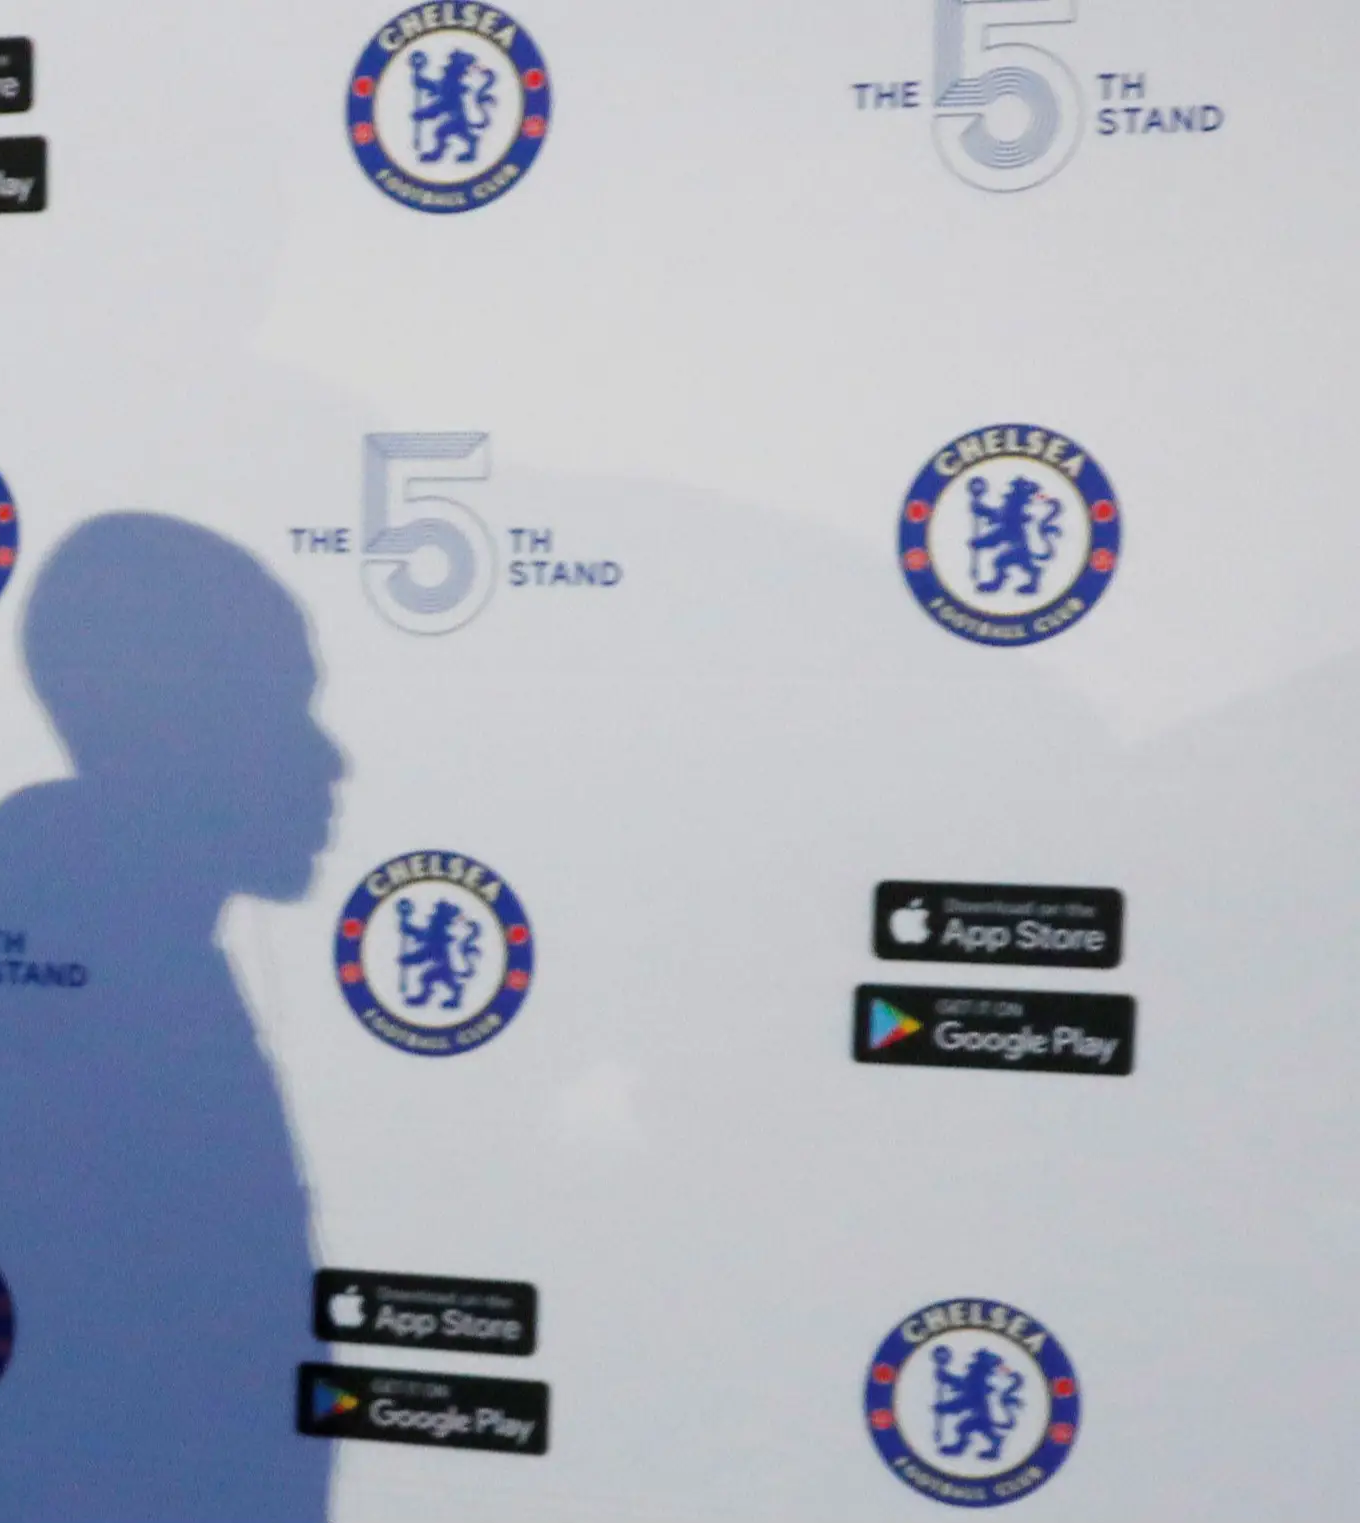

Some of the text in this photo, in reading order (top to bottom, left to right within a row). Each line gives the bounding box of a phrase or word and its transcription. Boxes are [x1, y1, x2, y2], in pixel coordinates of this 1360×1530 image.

[378, 2, 519, 51] CHELSEA
[851, 81, 921, 111] THE
[1096, 72, 1147, 102] TH
[1096, 104, 1225, 136] STAND
[934, 428, 1085, 478] CHELSEA
[289, 430, 554, 637] THE 5 TH
[508, 560, 624, 587] STAND
[366, 854, 502, 903] CHELSEA
[942, 916, 1107, 953] App Store
[934, 1021, 1120, 1065] Google Play
[374, 1304, 522, 1342] App Store
[903, 1302, 1047, 1352] CHELSEA
[368, 1399, 537, 1446] Google Play
